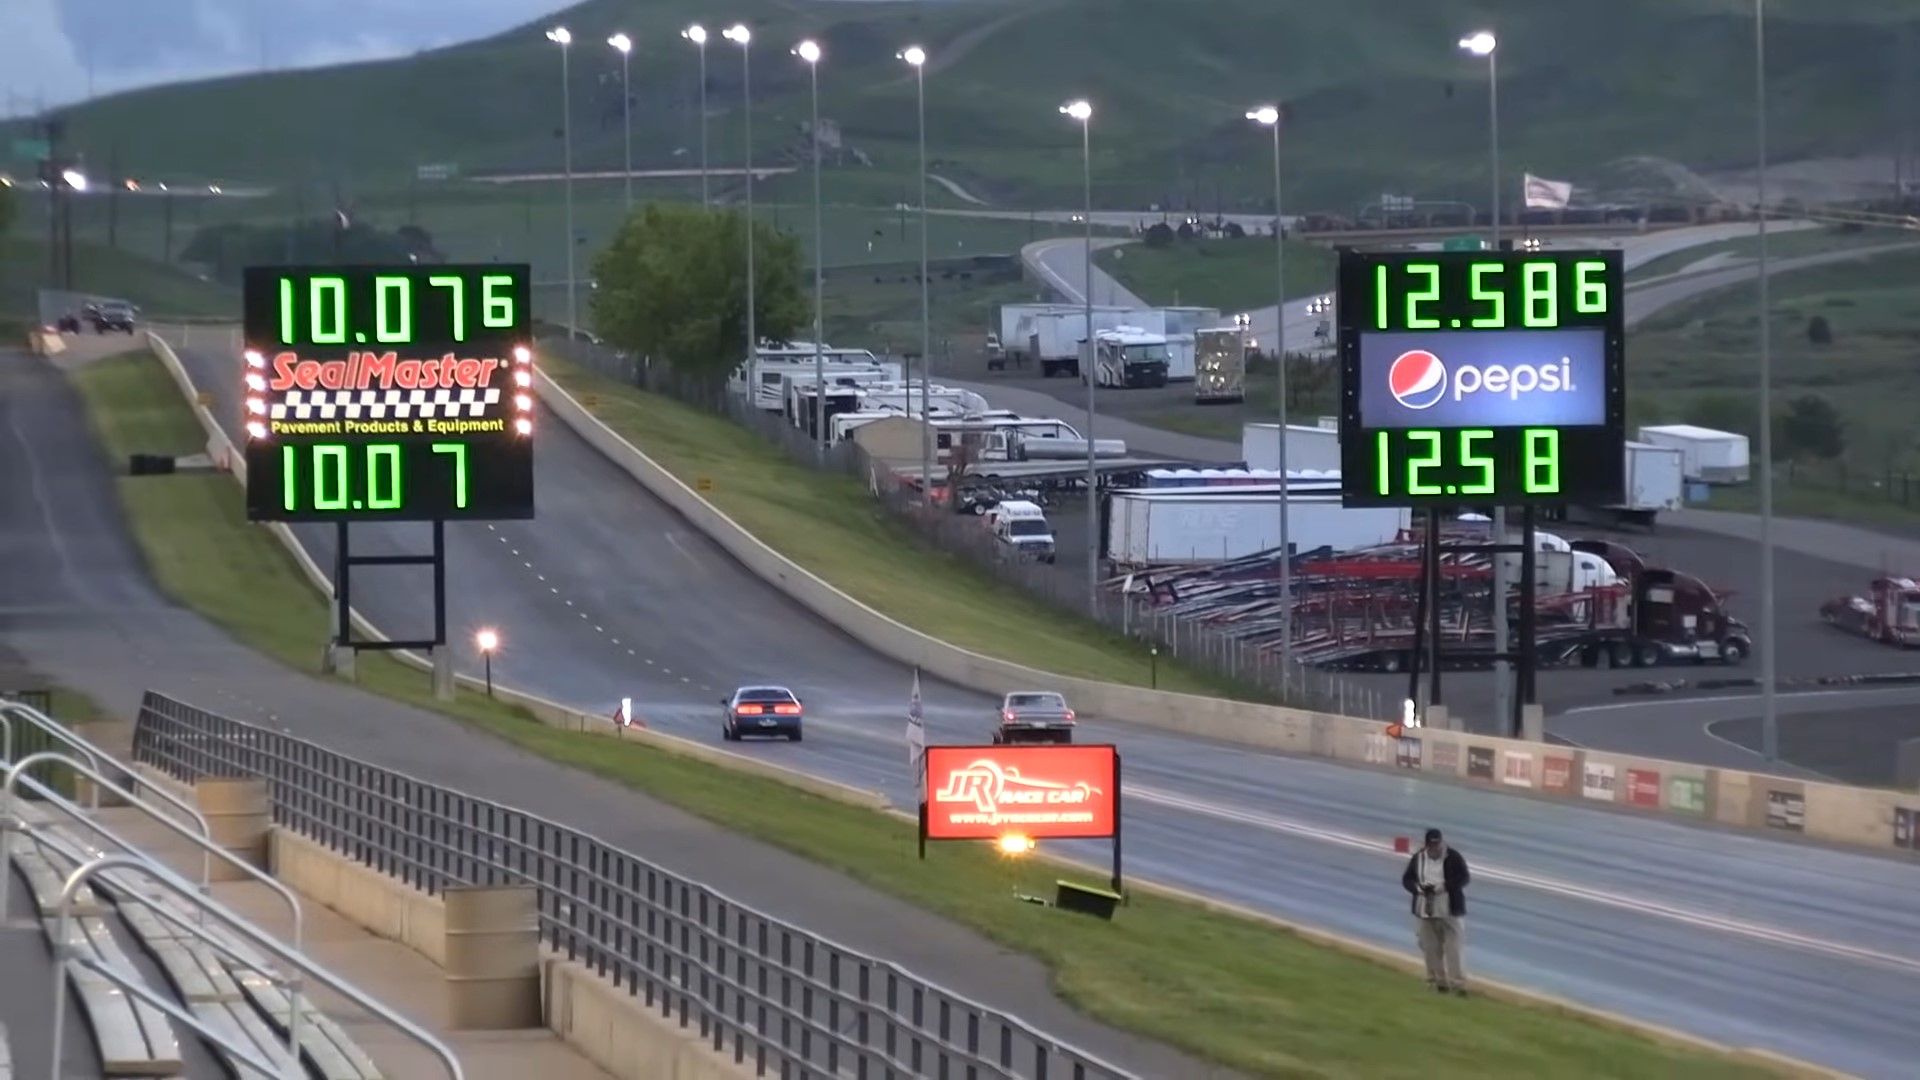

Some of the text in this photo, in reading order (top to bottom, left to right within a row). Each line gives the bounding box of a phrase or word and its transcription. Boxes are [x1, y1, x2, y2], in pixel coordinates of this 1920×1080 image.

[270, 351, 498, 390] SealMaster
[1454, 356, 1571, 402] pepsi
[271, 418, 505, 435] Pavement Products & Equipment
[1047, 788, 1084, 804] CAR
